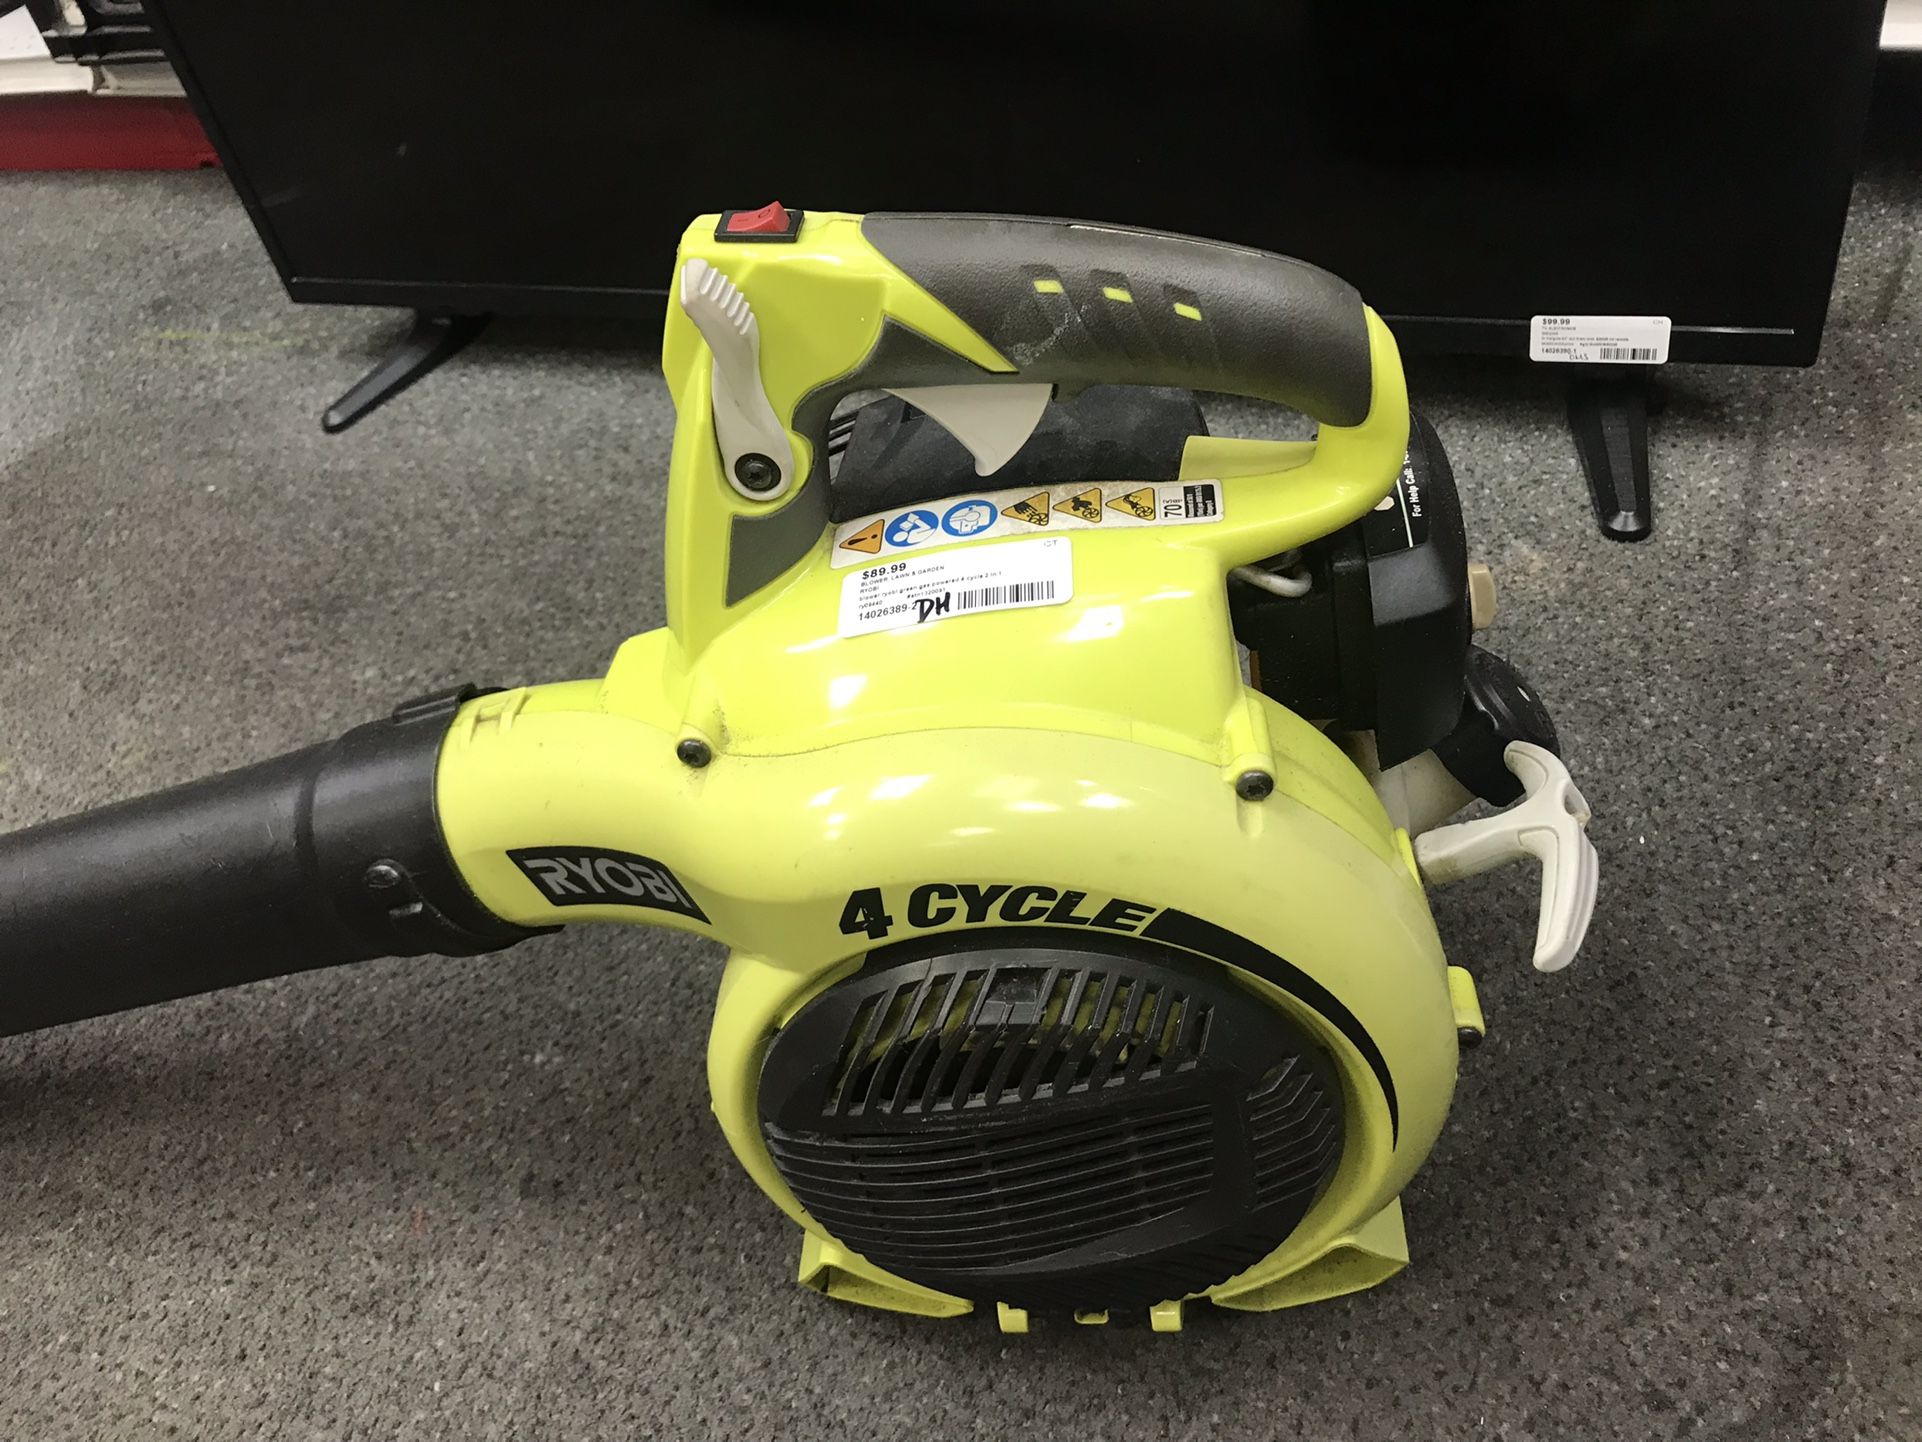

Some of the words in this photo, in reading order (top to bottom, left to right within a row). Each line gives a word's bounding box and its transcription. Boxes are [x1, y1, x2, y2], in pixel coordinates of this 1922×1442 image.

[1408, 485, 1420, 503] Help
[1164, 504, 1182, 518] 70
[1411, 504, 1422, 517] For
[862, 562, 906, 580] $89.99
[891, 571, 910, 581] LAWN
[917, 565, 945, 575] GARDEN
[860, 586, 880, 594] RYOBI
[899, 585, 918, 594] green
[967, 573, 983, 582] cycle
[859, 601, 917, 621] 14026389-2
[915, 591, 951, 624] DH
[523, 857, 693, 909] RYOBI
[839, 887, 893, 940] 4
[907, 883, 1156, 932] CYCLE
